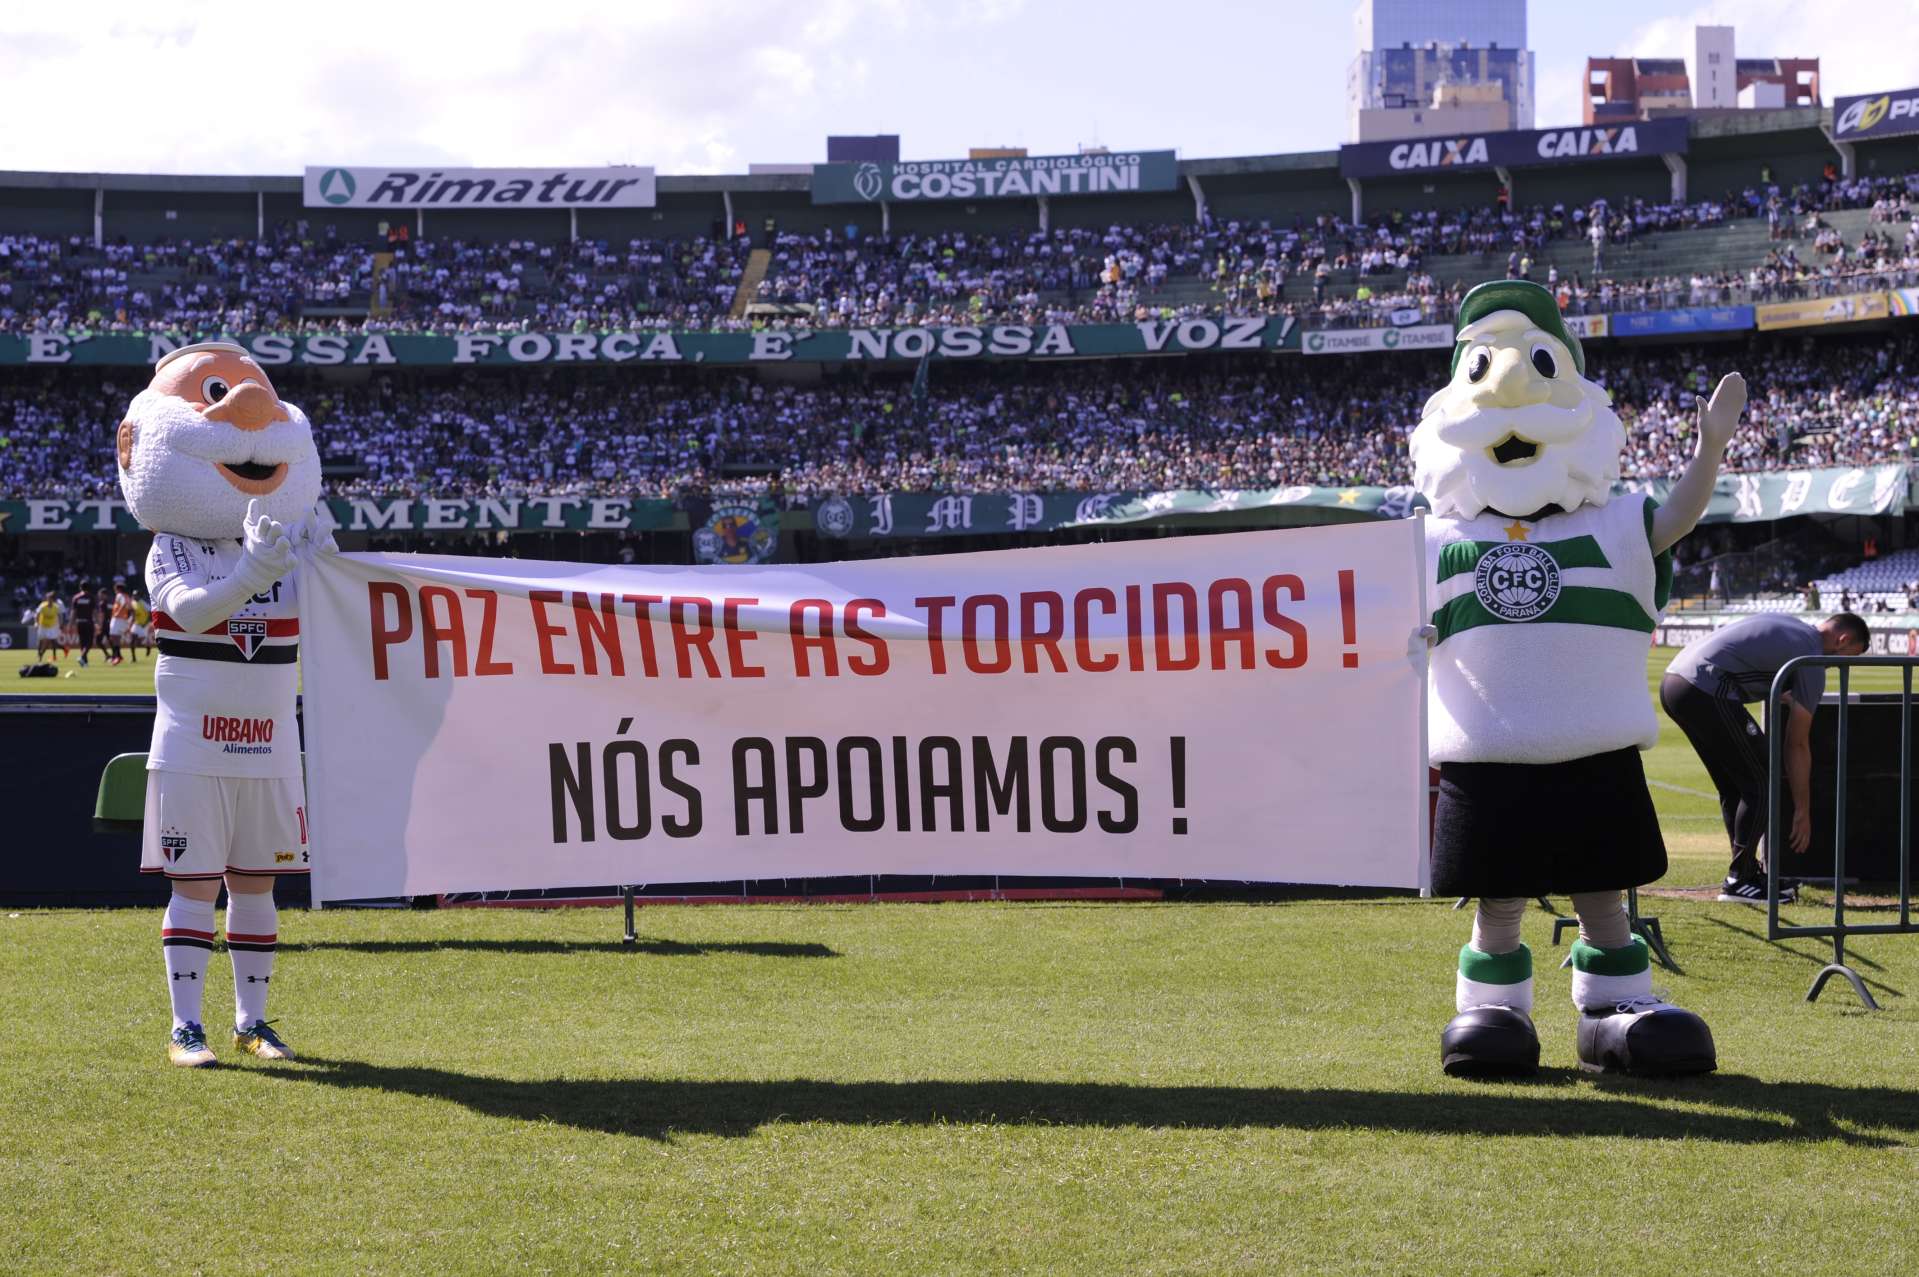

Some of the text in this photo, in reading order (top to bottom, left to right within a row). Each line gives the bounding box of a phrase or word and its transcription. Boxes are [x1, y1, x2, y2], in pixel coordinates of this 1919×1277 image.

[1389, 137, 1488, 170] CAIXA
[1537, 126, 1638, 159] CAIXA
[892, 154, 1141, 175] HOSPITAL CARDIOLÓGICO
[365, 171, 640, 204] Rimatur
[891, 165, 1140, 199] COSTANTINI
[147, 334, 397, 366] NSSA
[846, 325, 1076, 360] NOSSA
[1477, 554, 1497, 604] CORITIBA
[1545, 572, 1558, 600] CLUB
[1492, 570, 1543, 590] CFC
[230, 622, 265, 634] SPFC
[367, 581, 514, 681] PAZ
[528, 589, 766, 679] ENTRE
[788, 597, 891, 677] AS
[915, 573, 1309, 675] TORCIDAS
[202, 714, 274, 745] URBANO
[222, 742, 273, 755] Alimentos
[548, 717, 703, 844] NÓS
[731, 735, 1140, 837] APOIAMOS
[161, 838, 187, 848] SPFC
